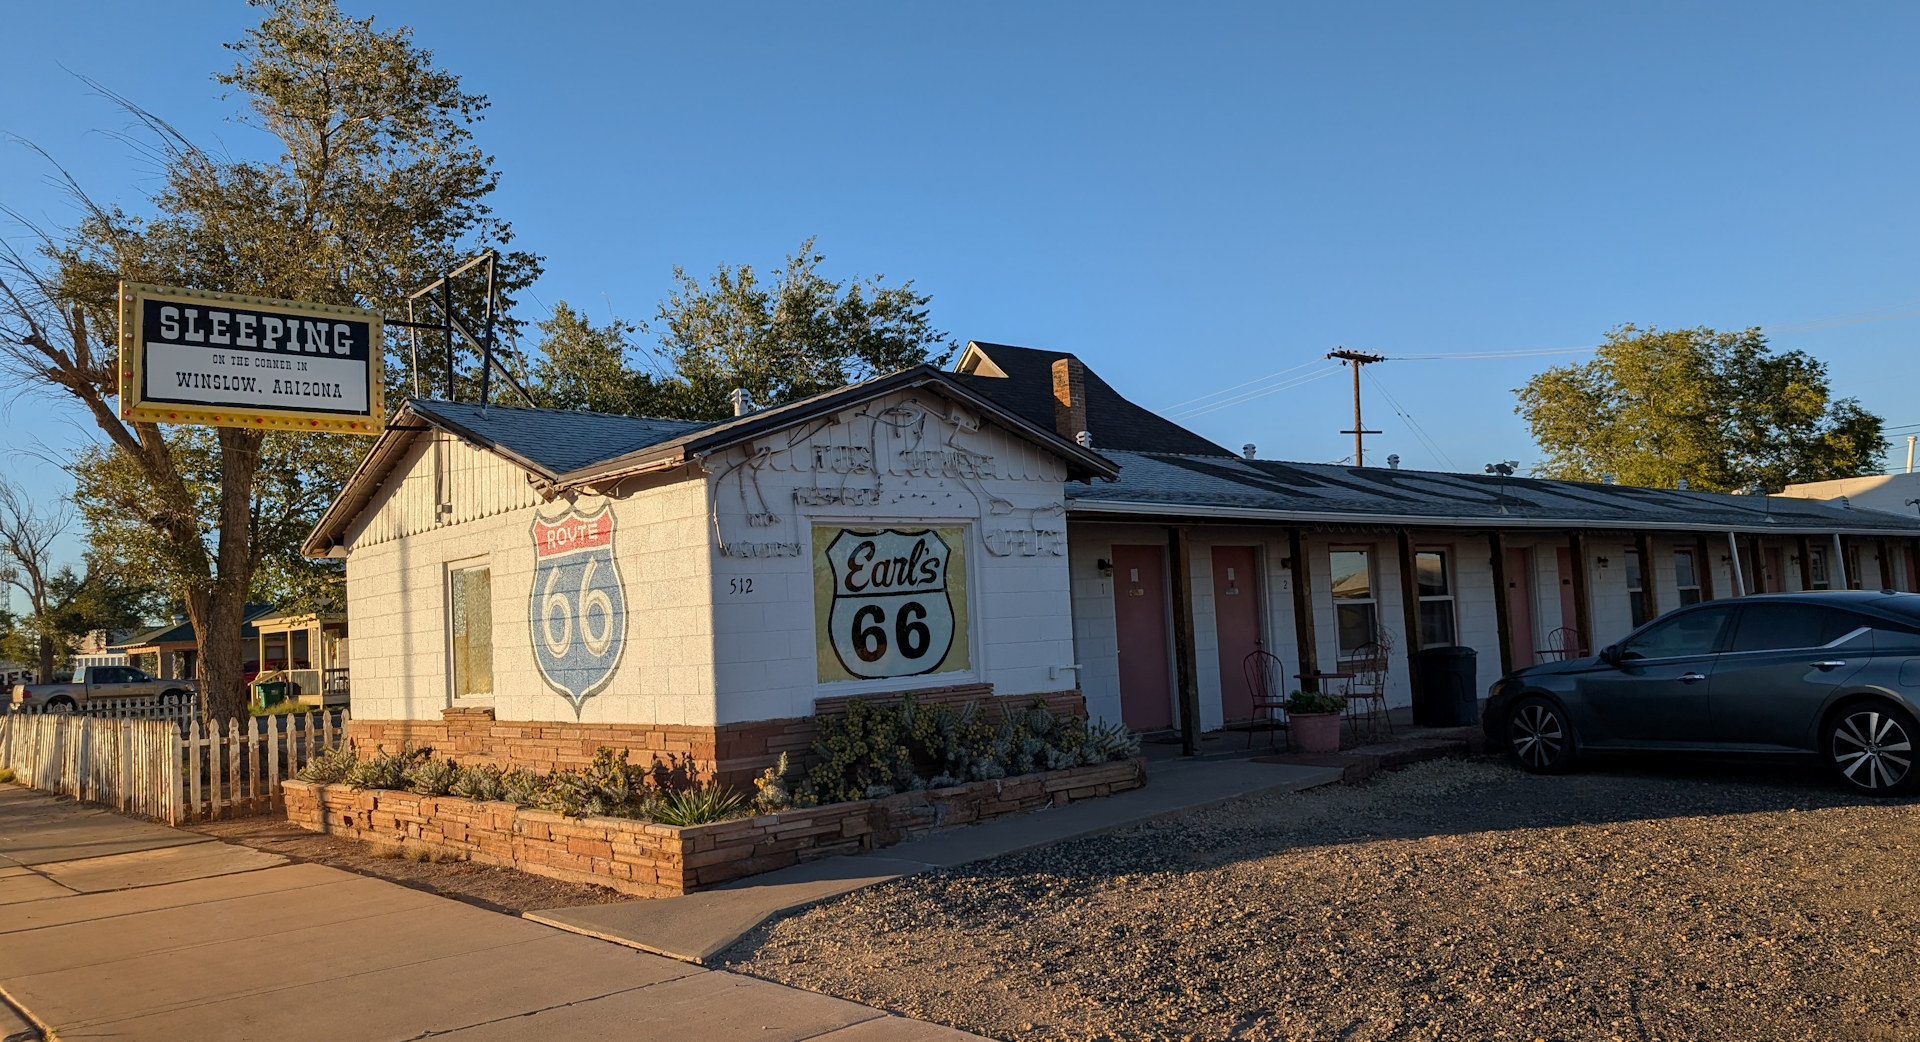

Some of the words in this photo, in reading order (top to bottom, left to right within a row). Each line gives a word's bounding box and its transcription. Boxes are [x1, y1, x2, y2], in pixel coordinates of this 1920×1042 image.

[160, 306, 354, 355] SLEEPING
[212, 353, 226, 365] ON
[230, 355, 250, 367] THE
[254, 356, 292, 370] CORNER
[296, 359, 308, 372] IN
[176, 371, 263, 394] WINSLOW,
[272, 378, 343, 399] ARIZONA
[748, 513, 777, 528] NO
[546, 522, 599, 549] ROUTE
[844, 538, 941, 593] Earl's
[729, 577, 753, 595] 512
[541, 555, 614, 659] 66
[851, 601, 931, 663] 66
